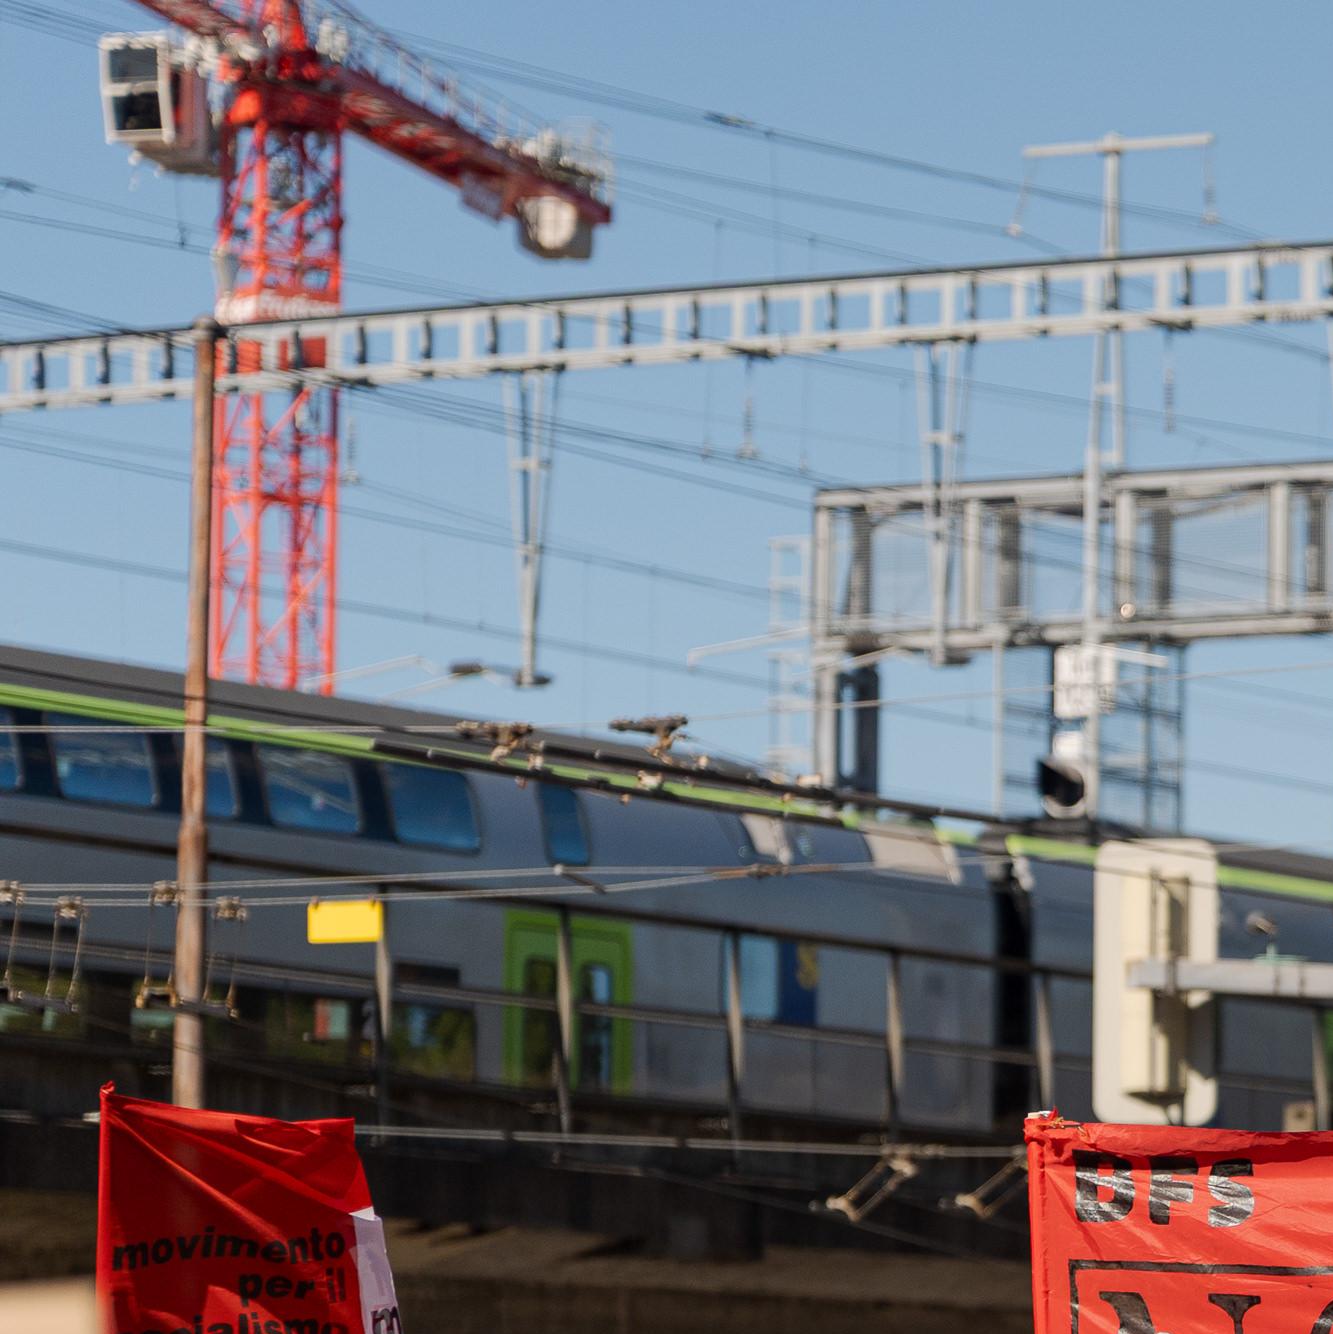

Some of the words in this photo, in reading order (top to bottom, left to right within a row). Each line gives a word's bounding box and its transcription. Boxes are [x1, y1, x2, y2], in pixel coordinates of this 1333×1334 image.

[1073, 1149, 1254, 1228] BFS
[111, 1226, 346, 1271] movimento
[238, 1273, 316, 1307] per
[324, 1267, 346, 1303] il
